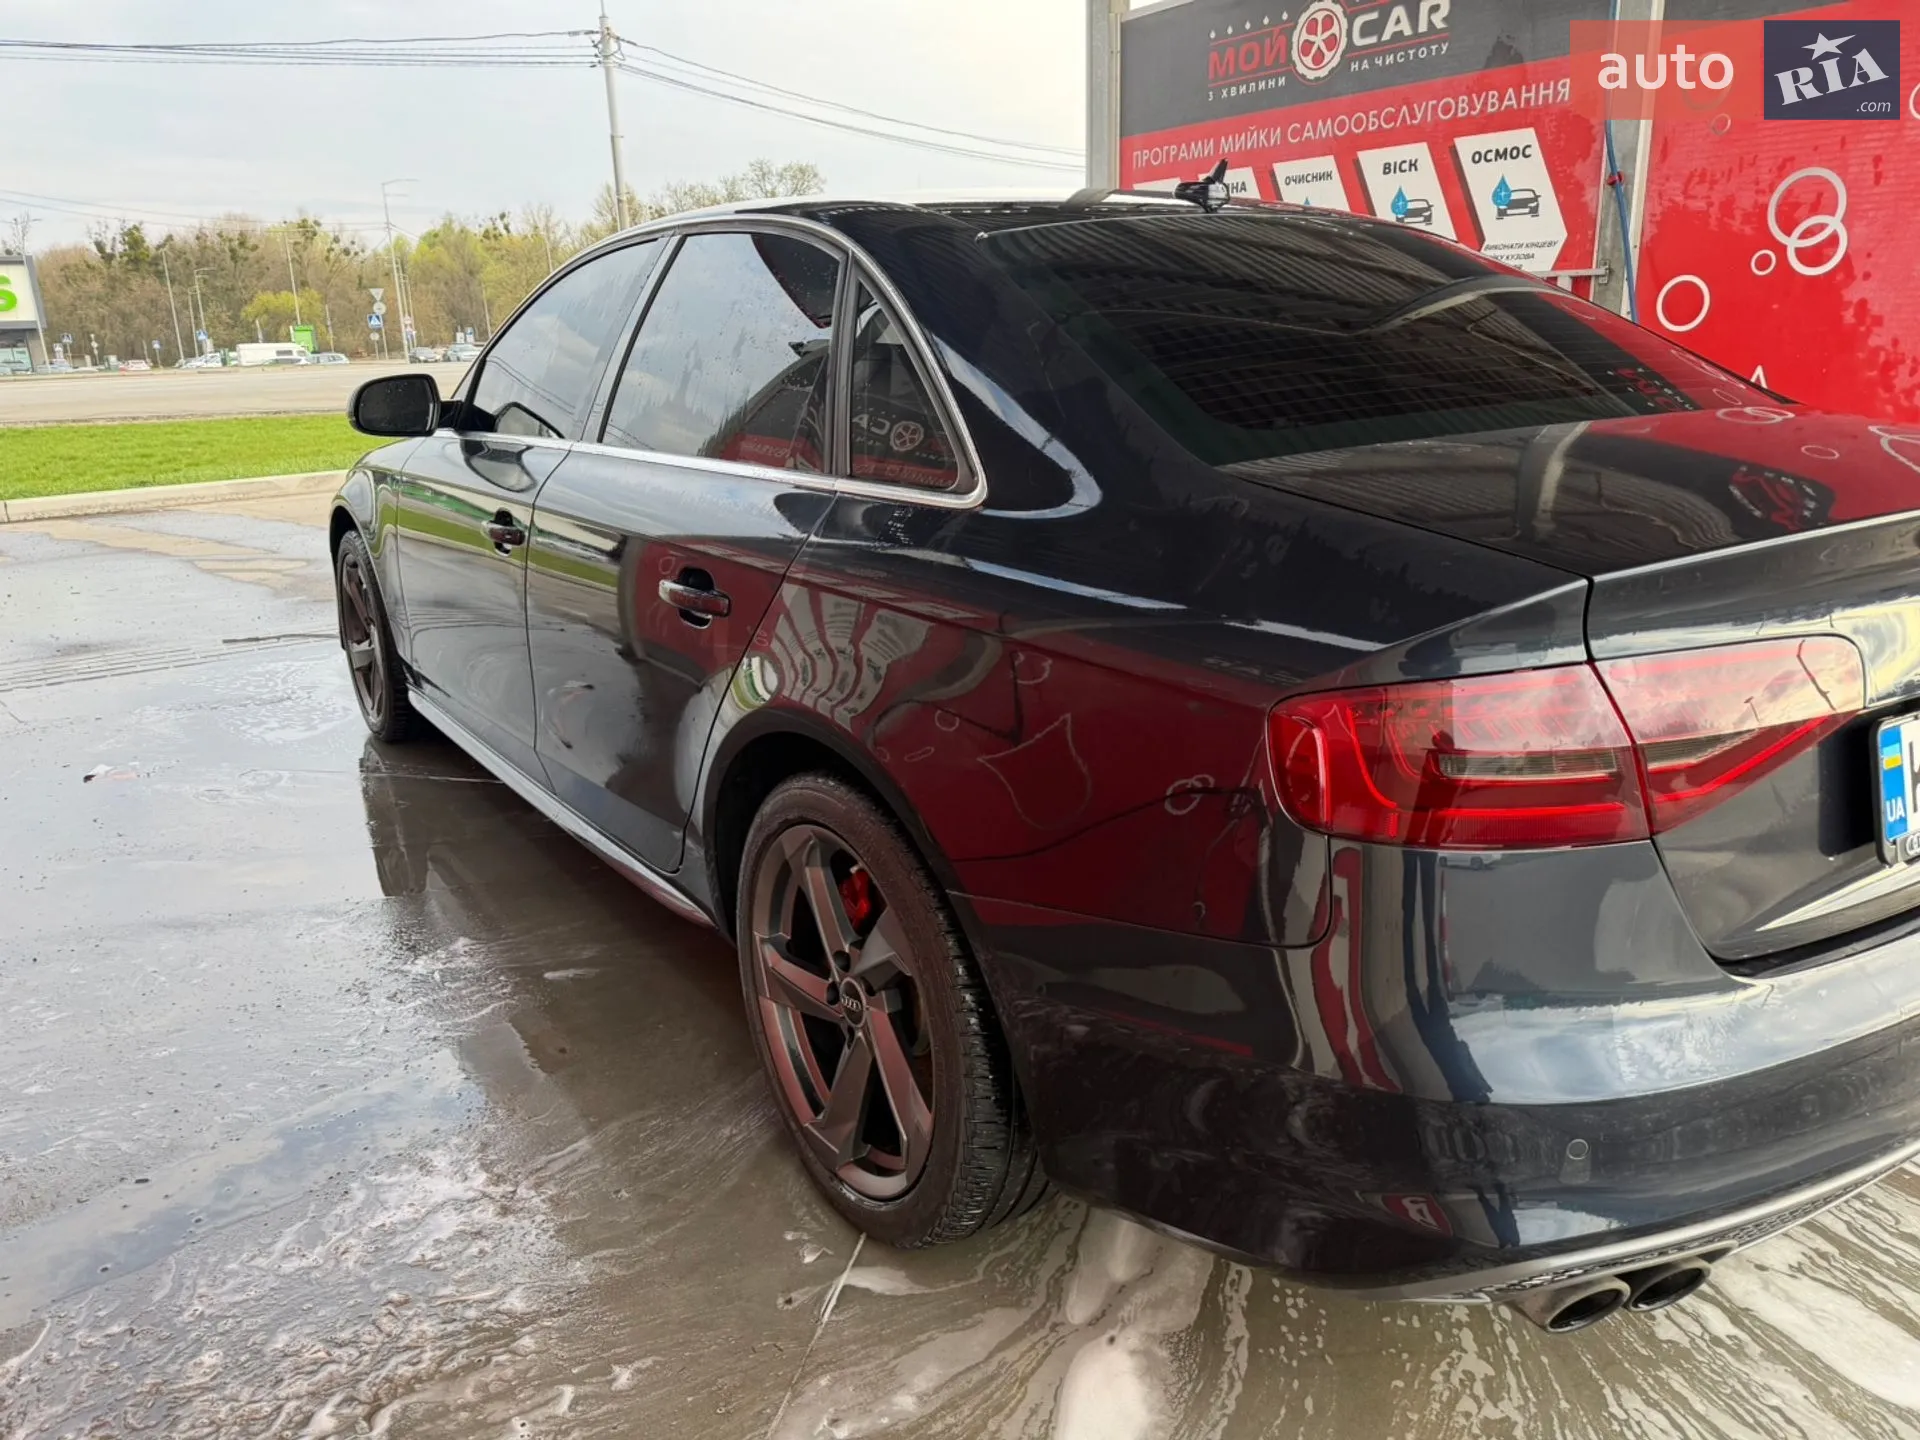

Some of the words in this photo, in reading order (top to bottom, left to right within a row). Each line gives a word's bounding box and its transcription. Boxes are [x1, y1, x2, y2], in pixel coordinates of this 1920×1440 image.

[1208, 29, 1290, 81] МОЙ
[1221, 76, 1287, 99] ХВИЛИНИ
[1350, 59, 1371, 73] НА
[1375, 42, 1450, 68] ЧИСТОТУ
[1132, 139, 1215, 170] ПРОГРАМИ
[1219, 125, 1282, 155] МИЙКИ
[1287, 77, 1571, 144] САМООБСЛУГОВУВАННЯ
[1382, 157, 1419, 175] ВІСК
[1471, 144, 1533, 165] ОСМОС
[1284, 170, 1333, 186] ОЧИСНИК
[1886, 796, 1905, 822] UA
